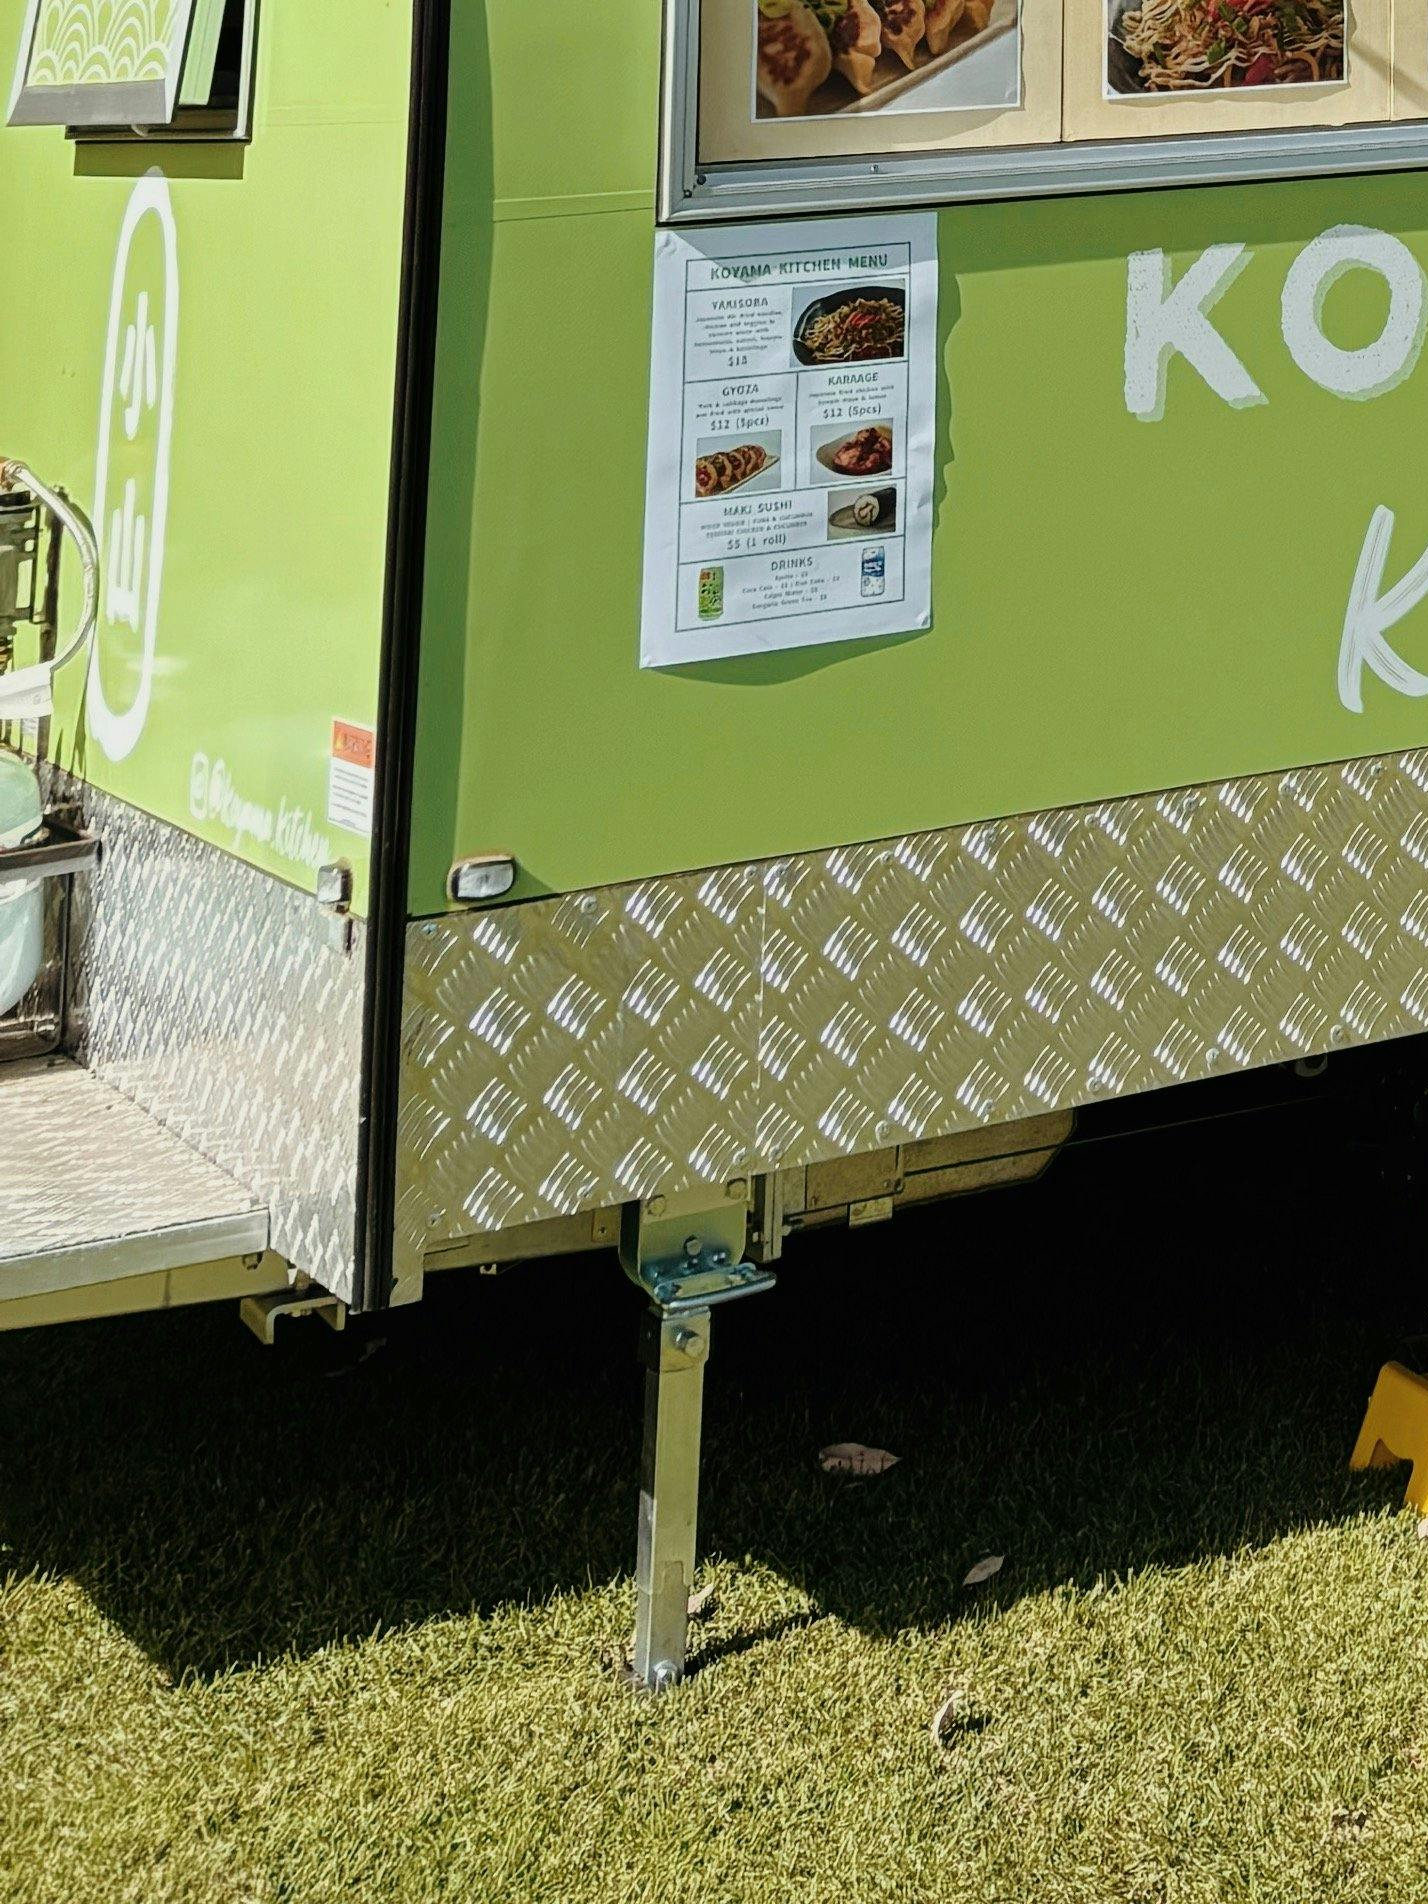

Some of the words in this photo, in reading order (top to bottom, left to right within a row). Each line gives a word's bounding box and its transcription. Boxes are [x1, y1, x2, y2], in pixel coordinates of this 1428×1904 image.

[711, 263, 772, 280] KOYAMA
[778, 258, 841, 275] KITCHEN
[848, 253, 888, 269] MENU
[828, 371, 879, 386] KARAAGE
[722, 383, 760, 397] GYOZA
[758, 499, 793, 513] SUSHI
[771, 556, 813, 572] DRINKS
